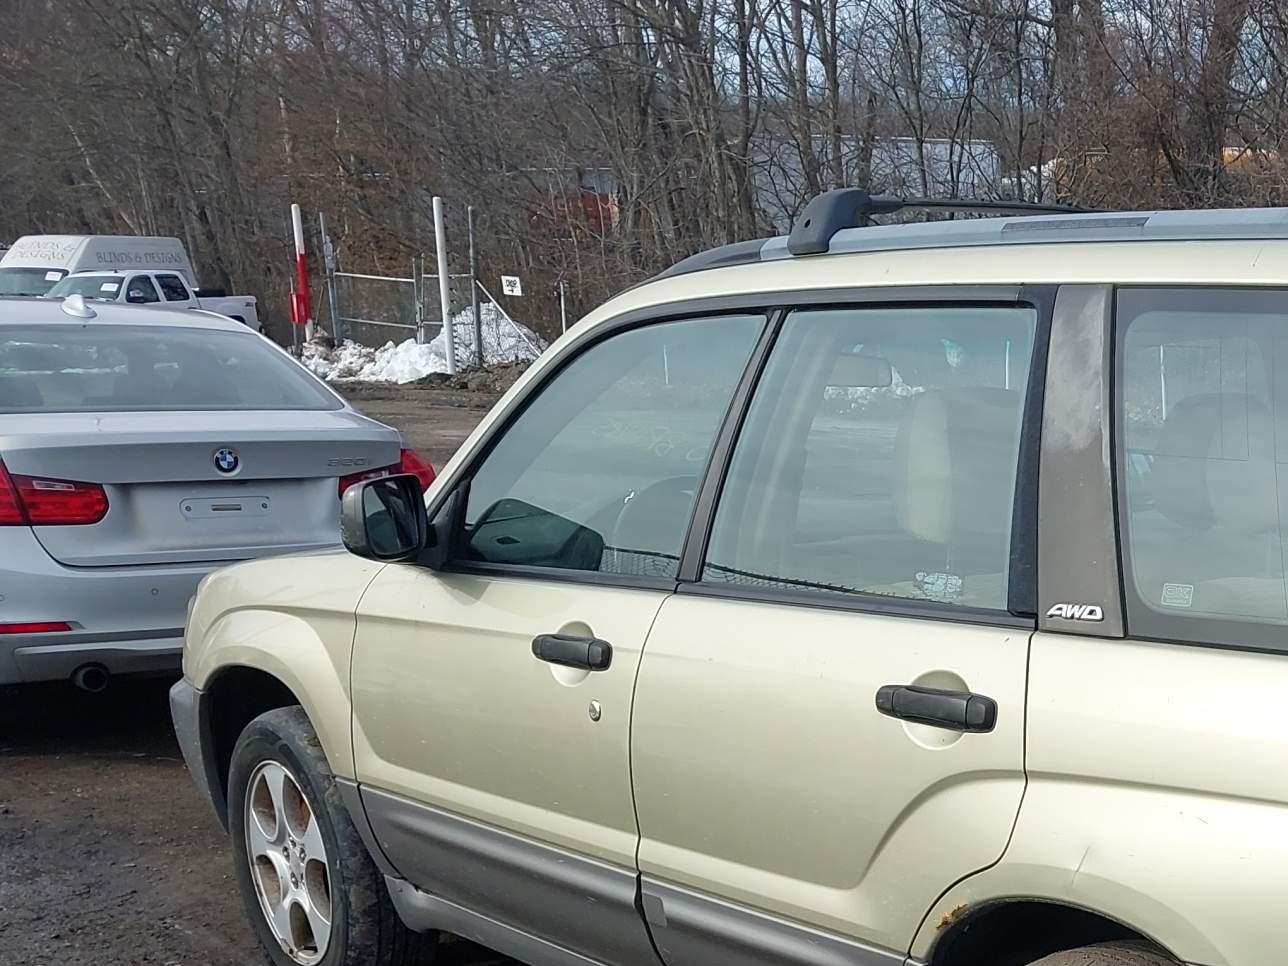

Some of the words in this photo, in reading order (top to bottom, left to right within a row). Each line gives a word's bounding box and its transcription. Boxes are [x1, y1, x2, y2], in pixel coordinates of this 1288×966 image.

[96, 252, 132, 264] BLINDS
[144, 252, 182, 264] DESIGNS
[1046, 603, 1104, 621] AWD
